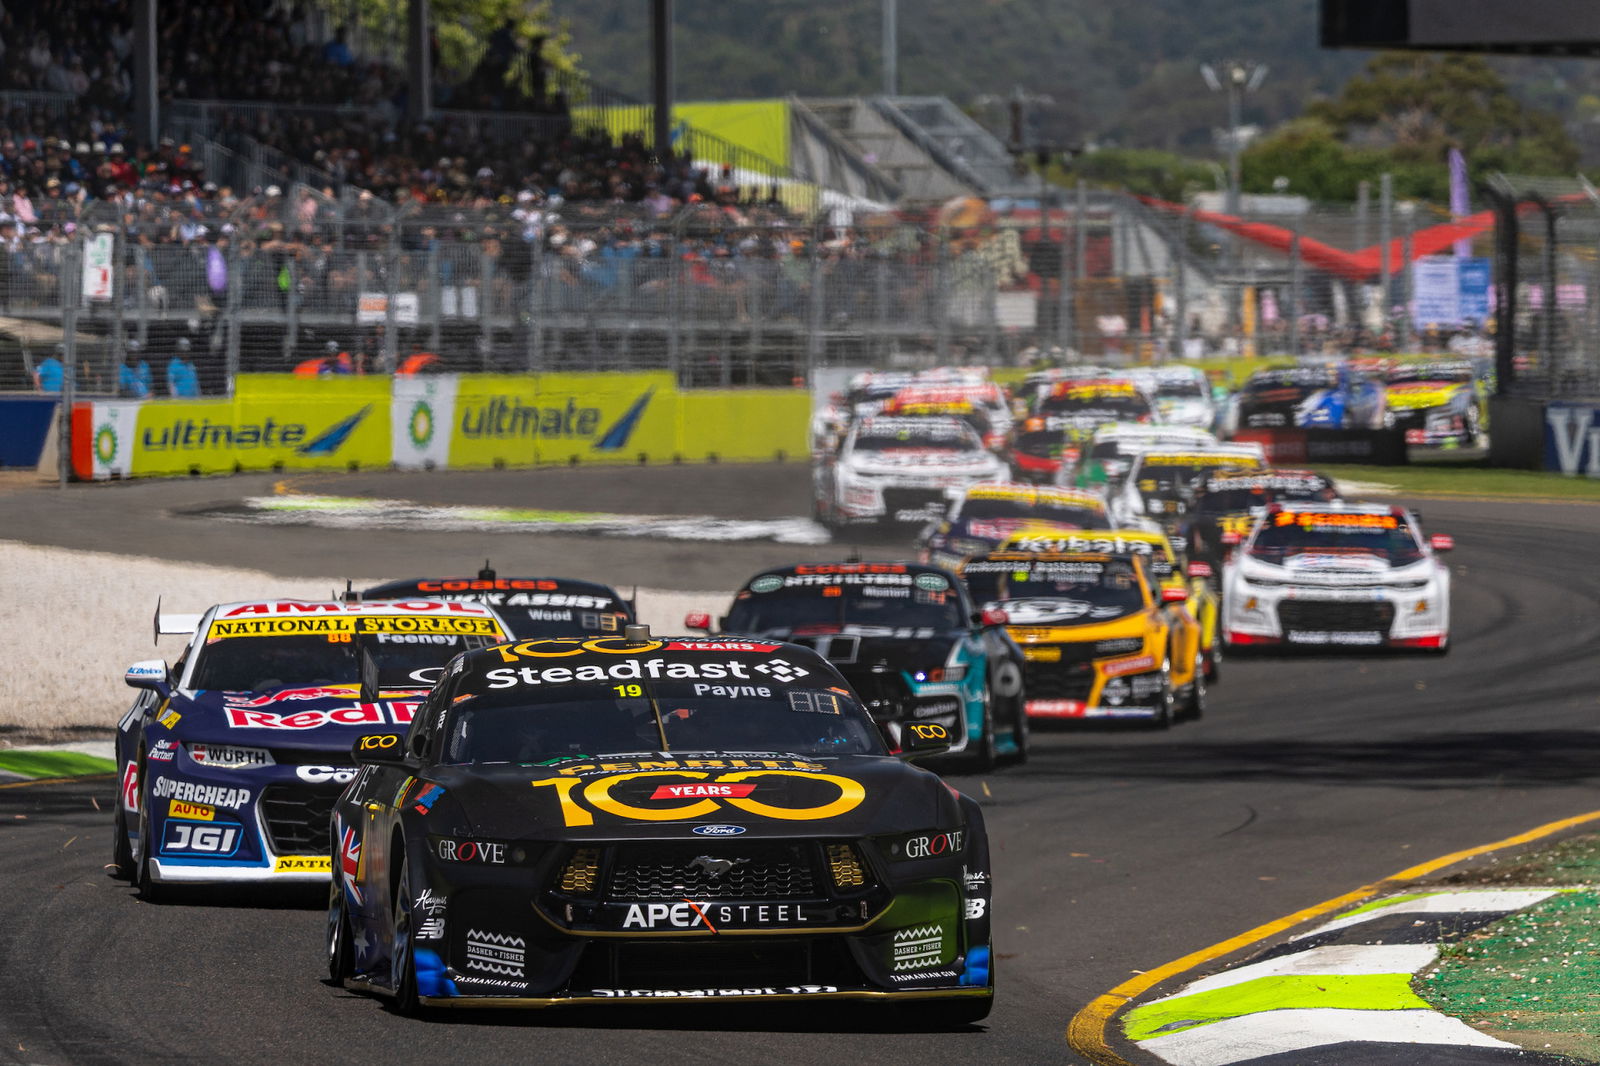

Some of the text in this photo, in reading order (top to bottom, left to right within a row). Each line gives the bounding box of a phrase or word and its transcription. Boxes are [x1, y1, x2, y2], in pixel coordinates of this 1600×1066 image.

[462, 396, 600, 440] ultimate
[142, 418, 306, 451] ultimate
[417, 579, 558, 592] coates
[527, 608, 573, 622] Wood
[215, 618, 492, 636] NATIONAL STORAGE
[377, 633, 458, 646] Feeney
[680, 642, 755, 650] YEARS
[485, 659, 750, 689] Steadfast
[613, 684, 642, 698] 19
[693, 683, 772, 699] Payne
[223, 701, 386, 730] Red
[910, 724, 947, 739] 100
[360, 735, 398, 750] 100
[208, 748, 266, 764] WÜRTH
[557, 759, 828, 776] PENRITE
[153, 775, 250, 810] SUPERCHEAP
[532, 770, 866, 827] 100
[669, 785, 732, 797] YEARS
[173, 803, 210, 817] AUTO
[703, 826, 736, 834] Ford
[165, 825, 237, 852] JGI
[905, 831, 963, 858] GROVE
[438, 839, 505, 864] GROVE
[622, 899, 808, 935] APEX STEEL
[467, 945, 493, 957] DASHER
[499, 951, 525, 962] FISHER
[894, 946, 918, 956] DASHER
[922, 942, 942, 952] FISHER
[454, 975, 529, 989] TASMANIAN GIN
[890, 971, 942, 982] TASMANIAN
